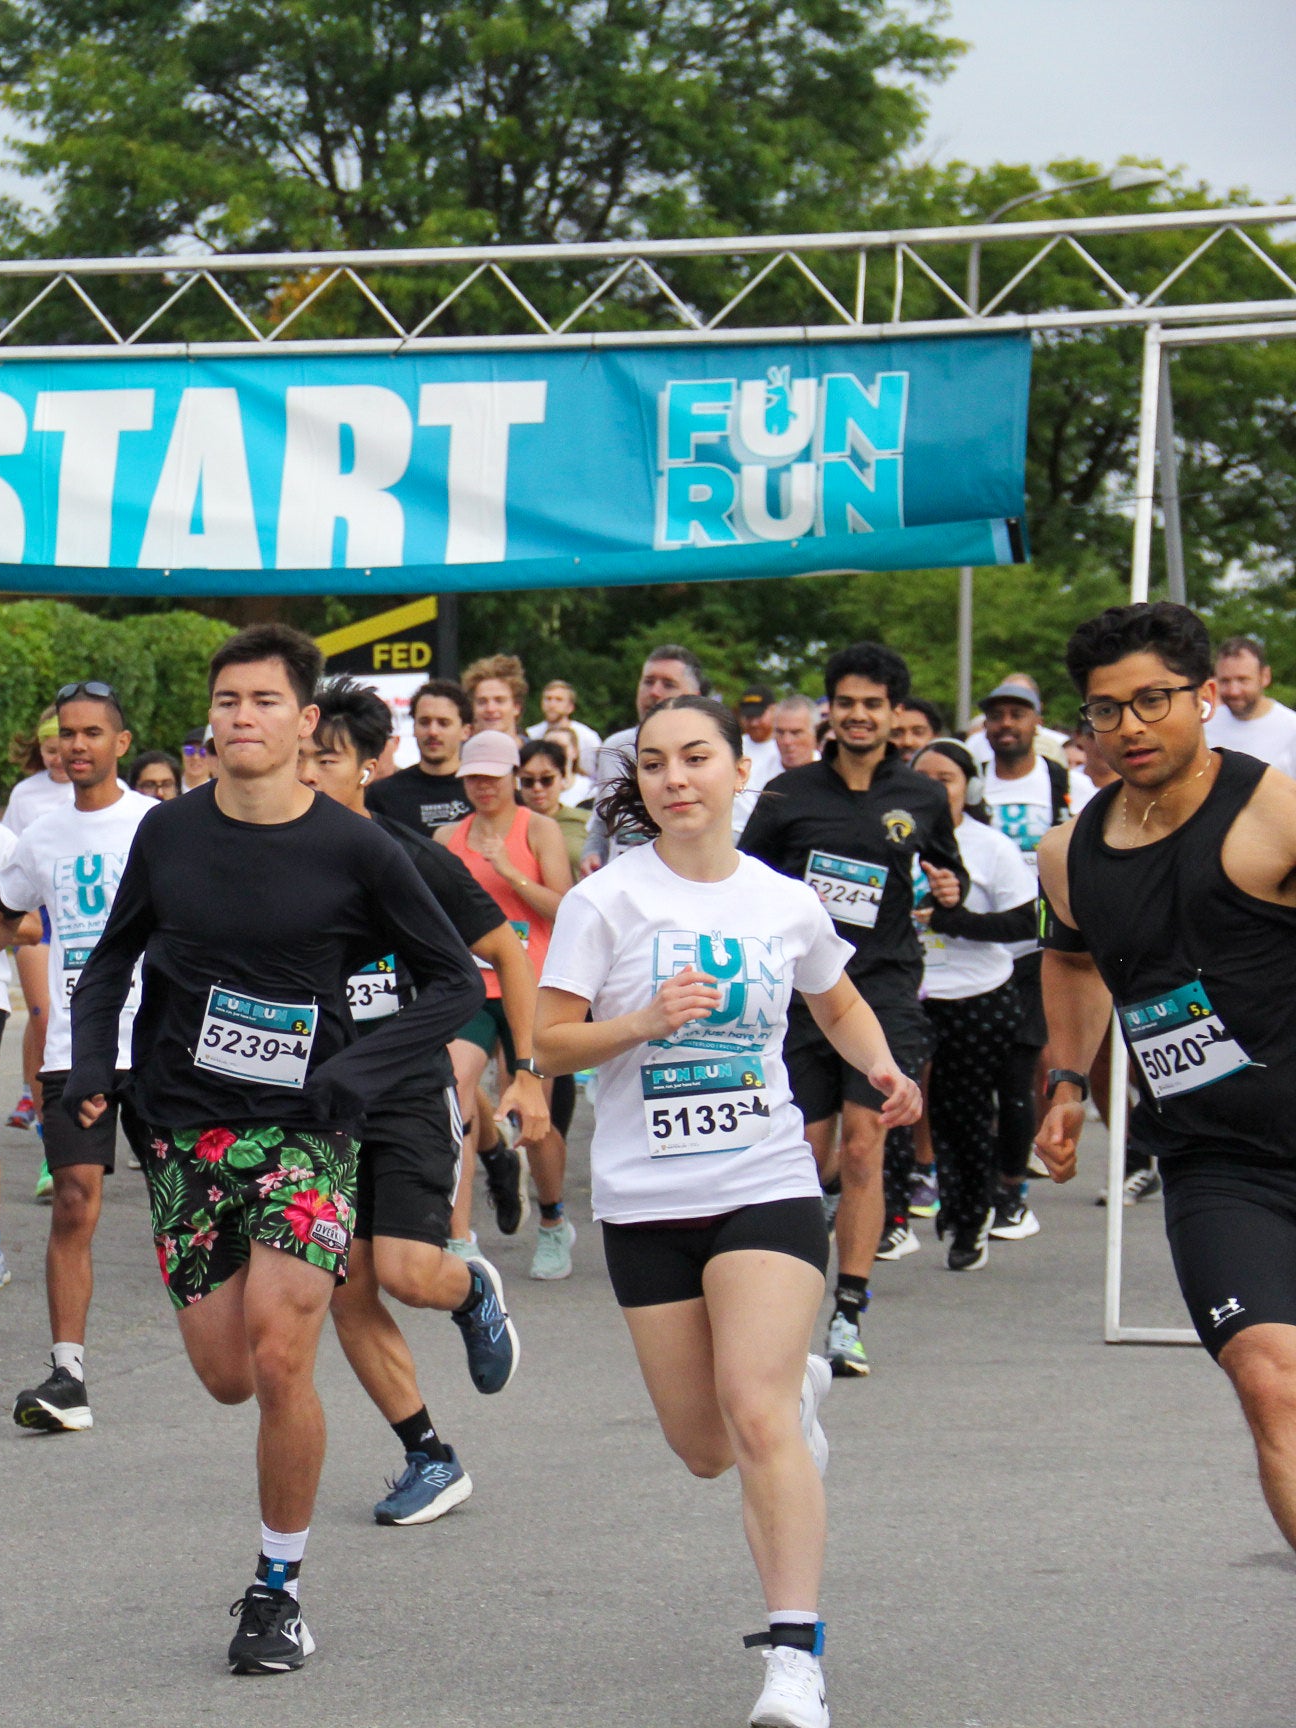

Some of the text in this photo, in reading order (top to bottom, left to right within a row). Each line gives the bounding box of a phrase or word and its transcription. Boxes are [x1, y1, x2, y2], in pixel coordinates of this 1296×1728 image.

[658, 369, 909, 467] FUN
[654, 455, 905, 550] RUN
[372, 641, 432, 670] FED
[55, 884, 120, 921] RU
[653, 930, 786, 983] FUN
[653, 981, 784, 1029] UN
[1189, 1004, 1200, 1016] 5
[203, 1023, 280, 1062] 5239
[294, 1022, 303, 1032] 5
[653, 1063, 732, 1084] FUN RUN
[1140, 1037, 1207, 1080] 5020
[744, 1073, 754, 1085] 5
[653, 1103, 738, 1139] 5133
